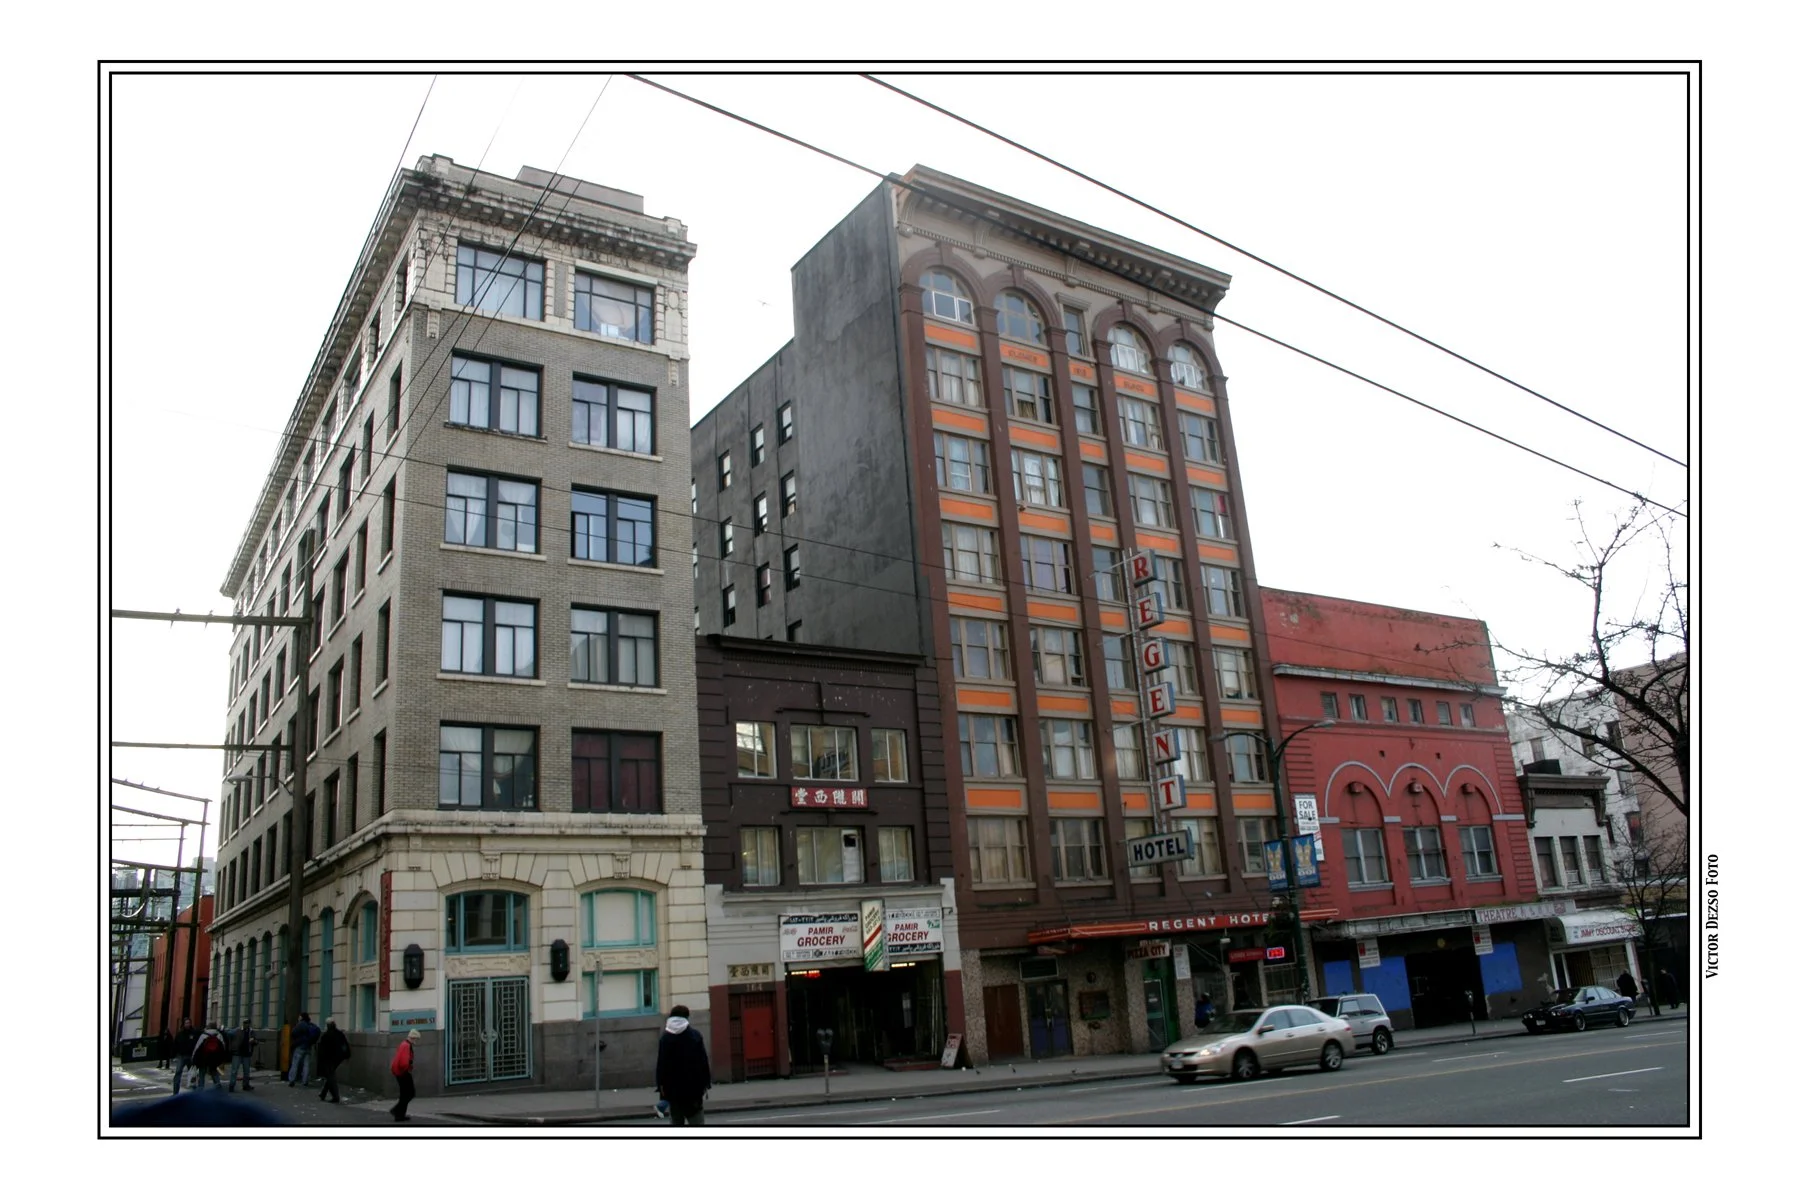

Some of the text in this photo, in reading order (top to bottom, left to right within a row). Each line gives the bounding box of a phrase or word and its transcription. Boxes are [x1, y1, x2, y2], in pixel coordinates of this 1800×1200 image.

[1133, 557, 1175, 806] REGENT
[1299, 800, 1314, 809] FOR
[1299, 810, 1316, 820] SALE
[1133, 836, 1185, 862] HOTEL
[1477, 907, 1517, 922] THEATRE
[894, 923, 919, 931] PAMIR
[1149, 913, 1271, 931] REGENT HOTE
[808, 926, 834, 935] PAMIR
[797, 935, 845, 947] GROCERY
[1151, 944, 1166, 956] CITY
